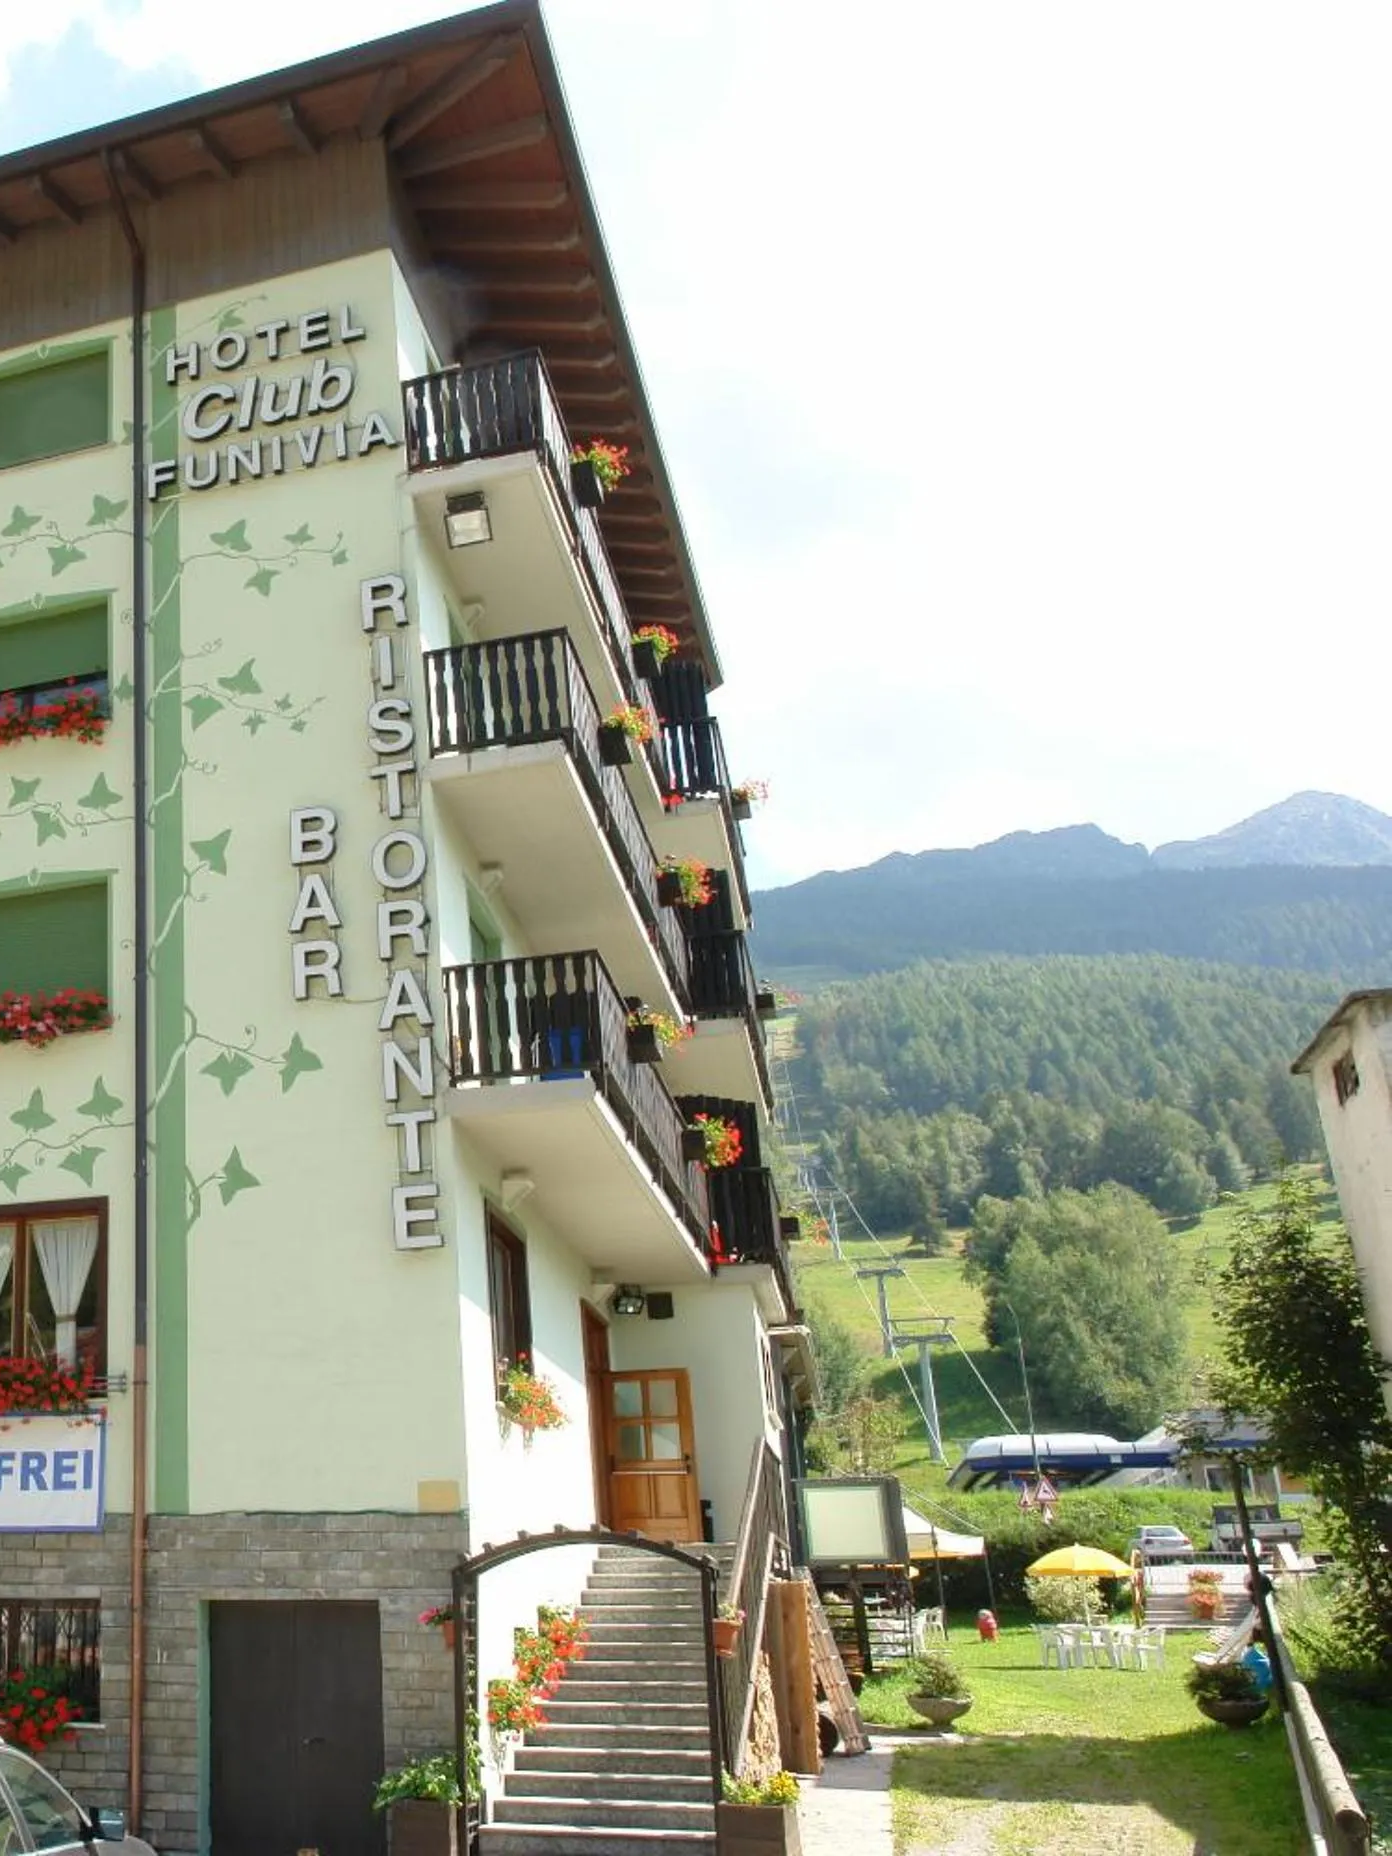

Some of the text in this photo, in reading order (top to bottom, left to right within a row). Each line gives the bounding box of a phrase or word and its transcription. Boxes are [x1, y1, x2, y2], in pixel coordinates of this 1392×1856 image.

[166, 303, 366, 385] HOTEL
[182, 358, 354, 441] Club
[147, 412, 398, 500] FUNIVIA
[289, 806, 343, 1000] BAR
[360, 573, 443, 1251] RISTORANTE
